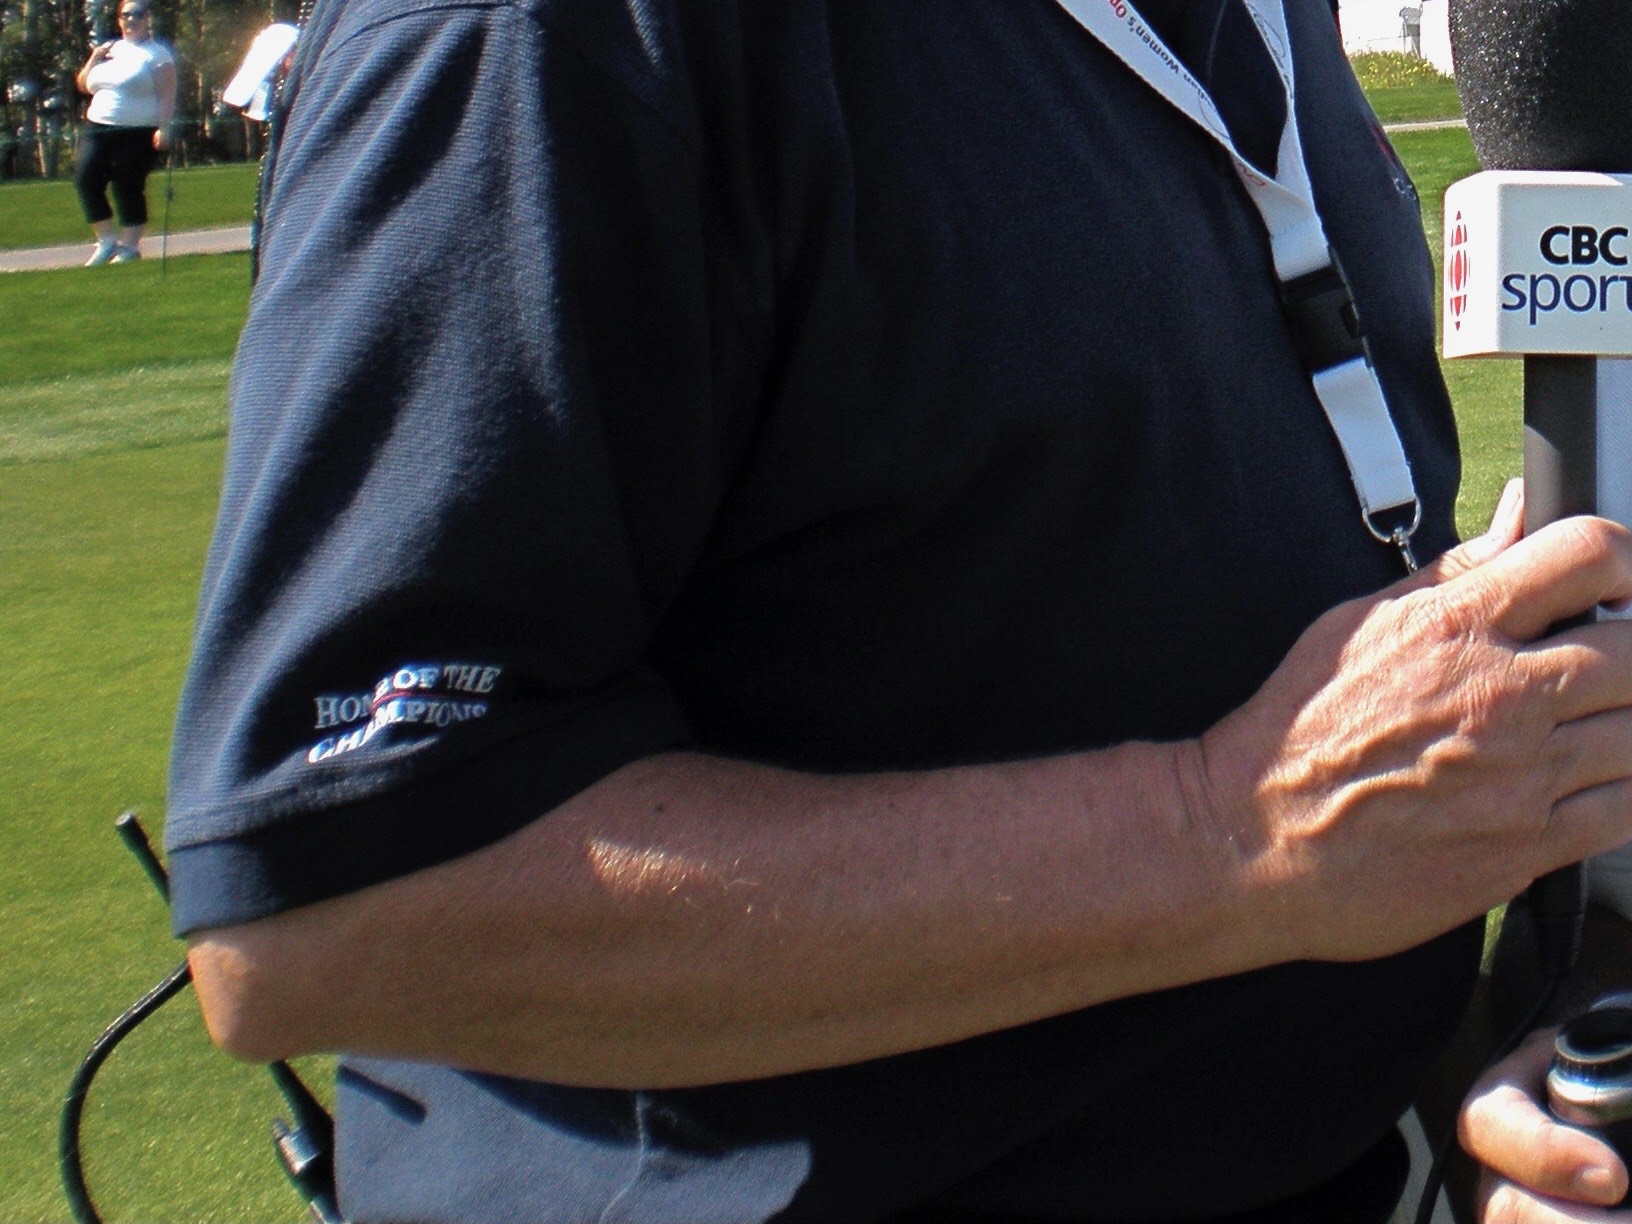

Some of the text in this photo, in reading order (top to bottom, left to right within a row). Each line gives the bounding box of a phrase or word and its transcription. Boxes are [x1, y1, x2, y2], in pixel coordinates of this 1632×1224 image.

[1126, 15, 1180, 74] Women's
[1539, 225, 1628, 266] CBC
[393, 667, 440, 689] OF
[444, 664, 501, 693] THE
